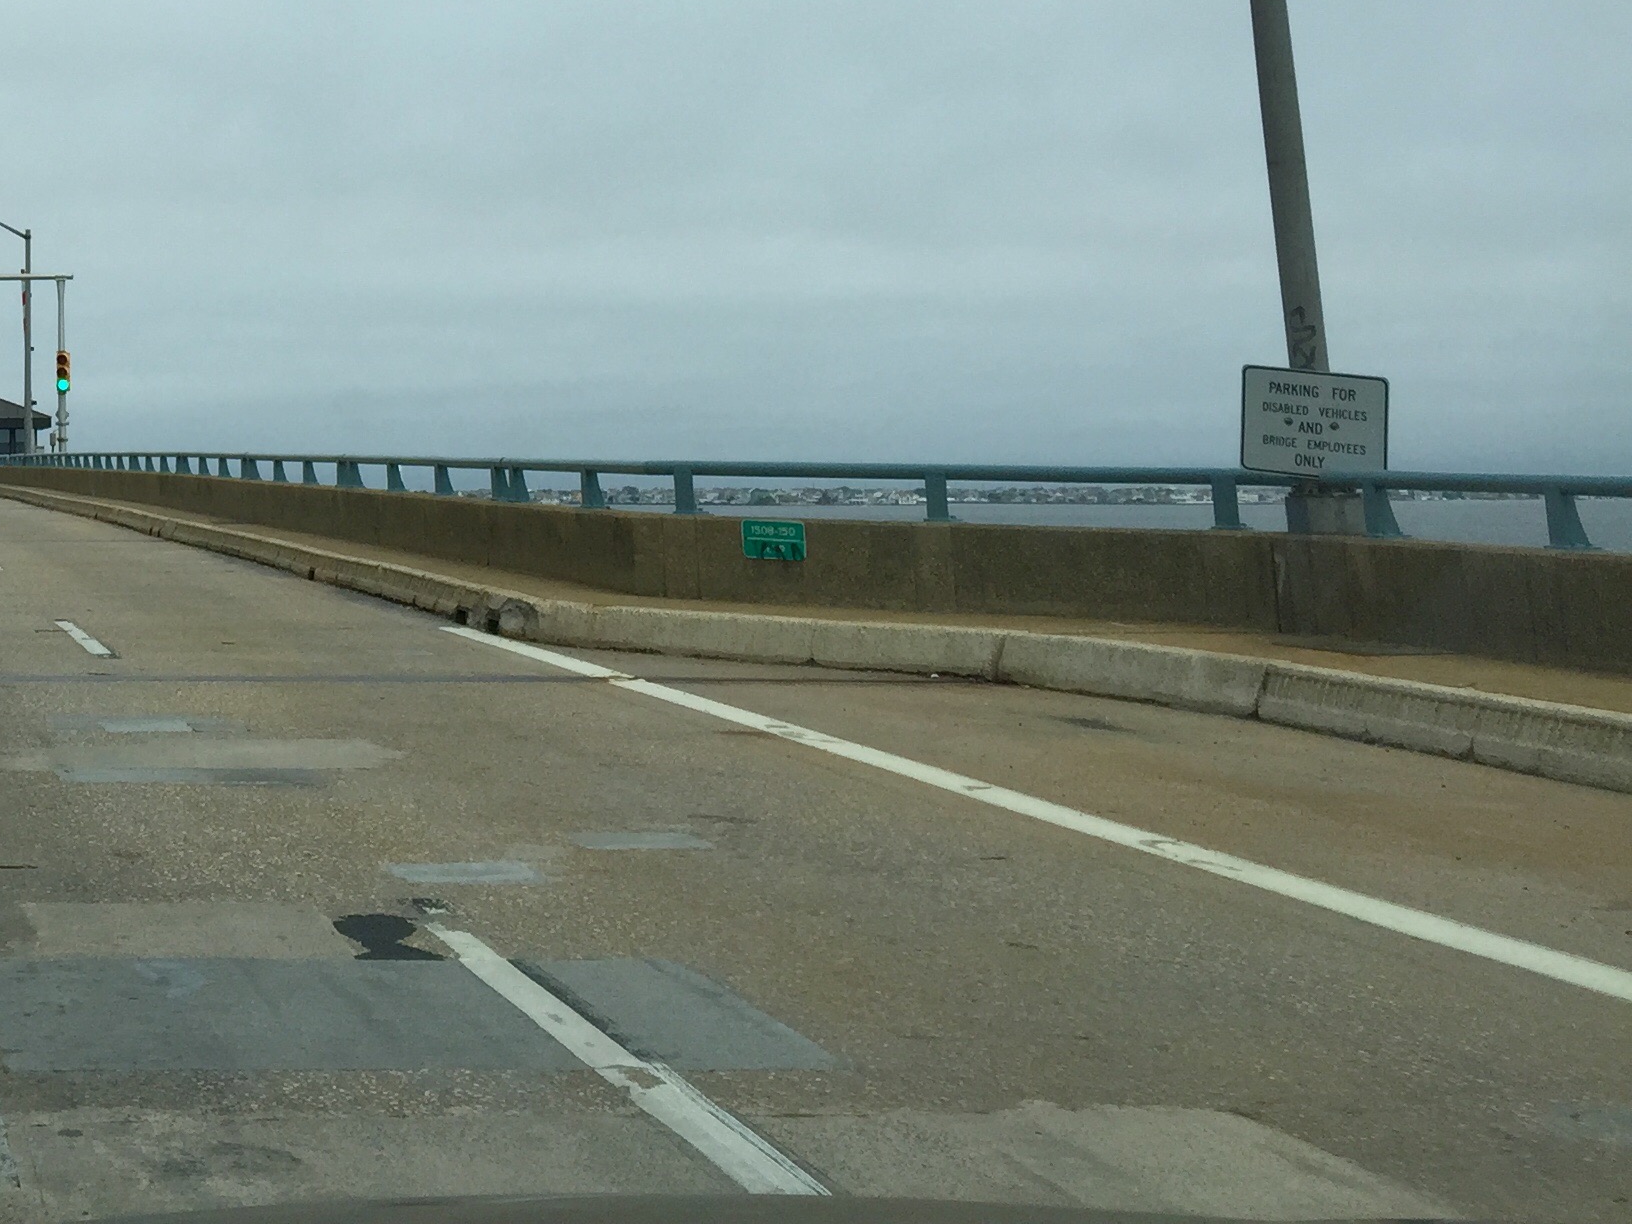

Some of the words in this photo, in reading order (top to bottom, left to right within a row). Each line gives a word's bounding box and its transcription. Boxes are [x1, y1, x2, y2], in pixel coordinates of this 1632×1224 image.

[1268, 381, 1320, 398] PARKING
[1332, 387, 1357, 402] FOR
[1262, 401, 1309, 416] DISABLED
[1319, 407, 1368, 422] VEHICLES
[1298, 421, 1323, 435] AND
[1262, 434, 1298, 448] BRIDGE
[1307, 439, 1367, 456] EMPLOYEES
[1294, 453, 1326, 469] ONLY
